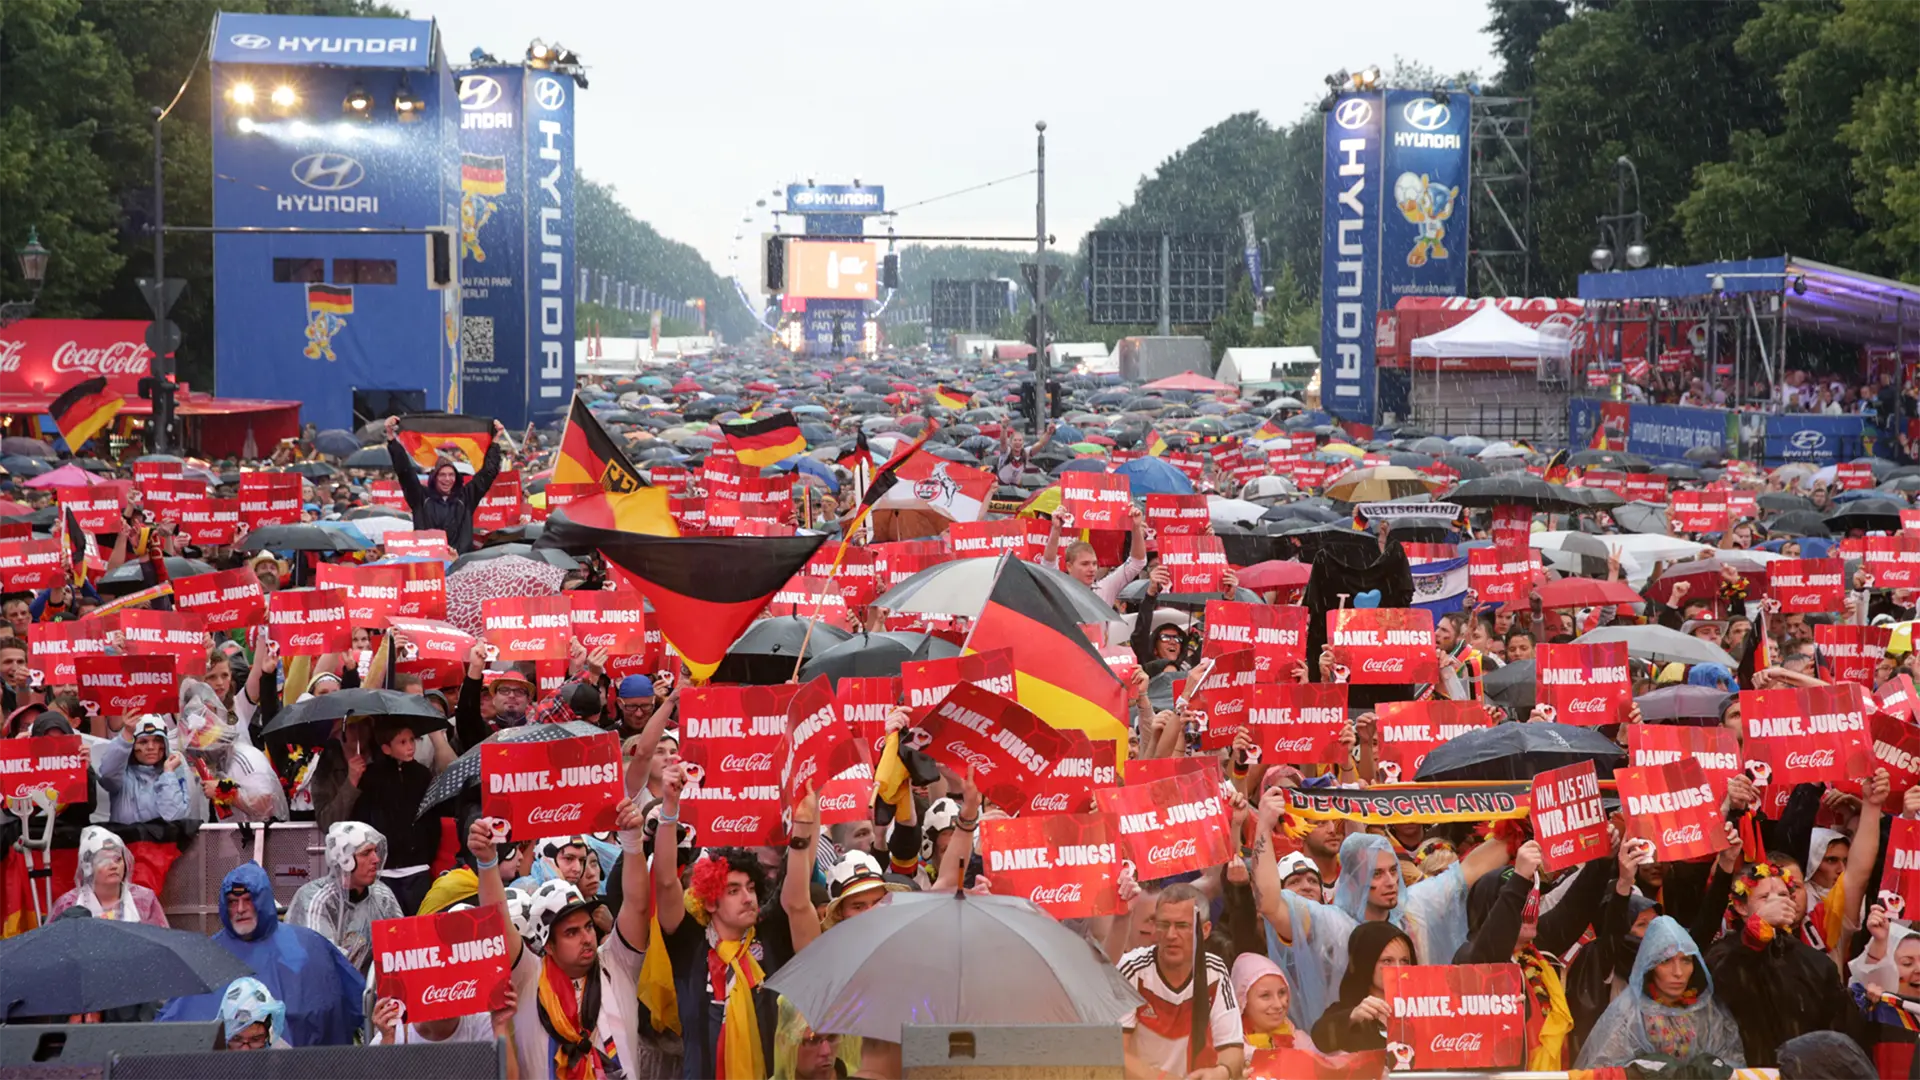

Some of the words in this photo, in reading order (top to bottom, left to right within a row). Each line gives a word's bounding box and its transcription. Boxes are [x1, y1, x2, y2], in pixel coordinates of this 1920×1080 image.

[278, 36, 418, 53] HYUNDAI
[1394, 132, 1461, 149] HYUNDAI
[277, 194, 379, 213] HYUNDAI
[814, 191, 878, 206] HYUNDAI
[539, 119, 563, 399] HYUNDAI
[1335, 138, 1366, 397] HYUNDAI
[704, 470, 732, 484] DANKE,
[240, 501, 269, 512] DANKE,
[270, 498, 298, 511] JUNGS!
[1065, 488, 1097, 502] DANKE,
[1097, 488, 1128, 503] JUNGS!
[182, 512, 211, 523] DANKE,
[212, 511, 239, 522] JUNGS!
[1149, 507, 1178, 519] DANKE,
[1179, 507, 1206, 519] JUNGS!
[1363, 504, 1460, 516] DEUTSCHLAND
[1675, 502, 1701, 513] DANKE,
[1701, 502, 1727, 513] JUNGS!
[955, 538, 990, 551] DANKE,
[26, 552, 60, 566] JUNGS!
[1163, 552, 1195, 565] DANKE,
[1866, 550, 1896, 563] DANKE,
[1469, 564, 1500, 576] DANKE,
[1500, 560, 1530, 575] JUNGS!
[1770, 575, 1807, 588] DANKE,
[1807, 572, 1842, 587] JUNGS!
[179, 589, 220, 608] DANKE,
[221, 583, 260, 602] JUNGS!
[358, 584, 398, 600] JUNGS!
[773, 592, 808, 605] DANKE,
[269, 611, 305, 625] DANKE,
[307, 606, 345, 623] JUNGS!
[486, 615, 527, 631] DANKE,
[529, 614, 569, 629] JUNGS!
[600, 609, 640, 623] JUNGS!
[125, 627, 164, 643] DANKE,
[1209, 623, 1253, 644] DANKE,
[1254, 627, 1300, 647] JUNGS!
[1333, 630, 1382, 648] DANKE,
[1384, 629, 1432, 647] JUNGS!
[32, 641, 71, 655] DANKE,
[82, 673, 127, 689] DANKE,
[128, 672, 173, 686] JUNGS!
[1542, 667, 1588, 686] DANKE,
[1588, 665, 1628, 684] JUNGS!
[1248, 706, 1295, 726] DANKE,
[1296, 706, 1344, 725] JUNGS!
[1749, 716, 1807, 738] DANKE,
[1808, 711, 1865, 735] JUNGS!
[686, 716, 748, 739] DANKE,
[793, 703, 838, 751] JUNGS!
[1383, 724, 1435, 743] DANKE,
[938, 700, 994, 739] DANKE,
[990, 727, 1051, 777] JUNGS!
[35, 754, 83, 772] JUNGS!
[720, 752, 774, 773] Coca-Cola
[1052, 757, 1093, 778] JUNGS!
[1785, 748, 1836, 770] Coca-Cola
[490, 770, 554, 795] DANKE,
[556, 761, 619, 788] JUNGS!
[1289, 787, 1517, 818] DEUTSCHLAND
[1535, 783, 1558, 811] WM,
[1558, 779, 1577, 806] DAS
[528, 803, 585, 825] Coca-Cola
[1164, 795, 1223, 827] JUNGS!
[1537, 811, 1567, 839] WIR
[1565, 797, 1605, 831] ALLE!
[711, 815, 762, 834] Coca-Cola
[990, 846, 1053, 872] DANKE,
[1055, 842, 1118, 867] JUNGS!
[1147, 837, 1198, 865] Coca-Cola
[1030, 883, 1084, 904] Coca-Cola
[382, 946, 447, 974] DANKE,
[447, 935, 507, 966] JUNGS!
[422, 979, 480, 1006] Coca-Cola
[1393, 994, 1457, 1019] DANKE,
[1456, 993, 1518, 1016] JUNGS!
[1430, 1031, 1484, 1054] Coca-Cola
